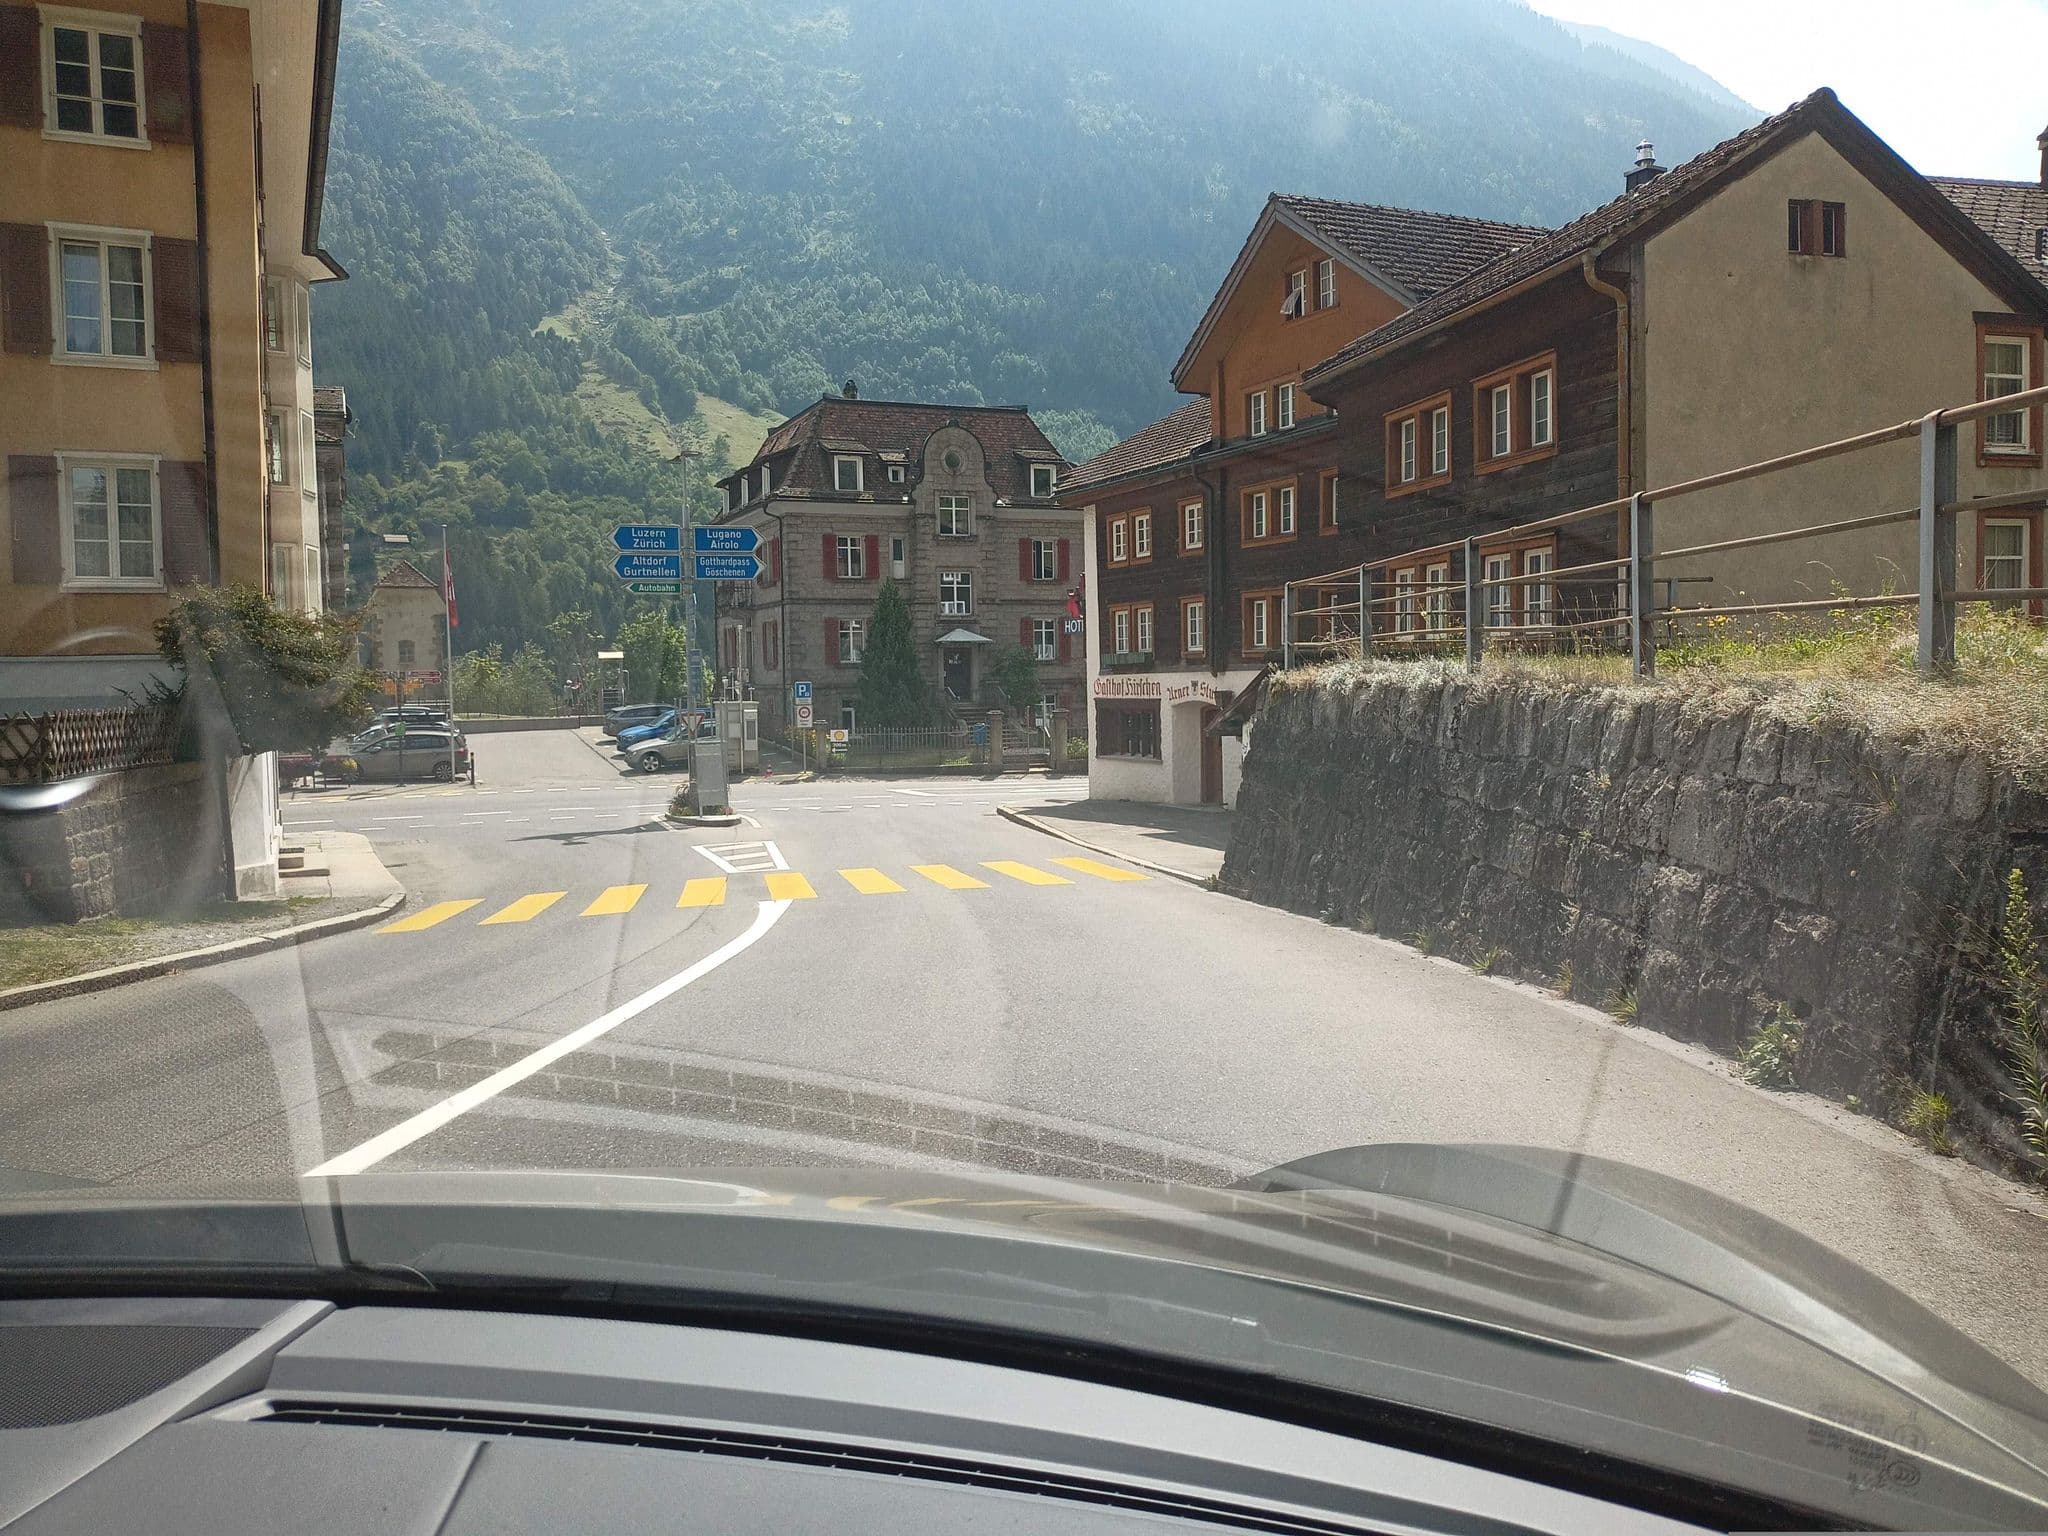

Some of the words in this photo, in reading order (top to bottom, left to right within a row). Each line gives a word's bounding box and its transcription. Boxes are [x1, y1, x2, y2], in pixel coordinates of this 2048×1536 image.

[631, 527, 666, 538] Luzern
[706, 529, 742, 540] Lugano
[633, 537, 666, 548] Zürich
[710, 539, 739, 549] Airolo
[632, 556, 667, 566] Altdorf
[699, 556, 750, 567] Gotthardpass
[623, 567, 676, 577] Gurtnellen
[638, 583, 676, 592] Autobahn
[799, 685, 806, 696] P
